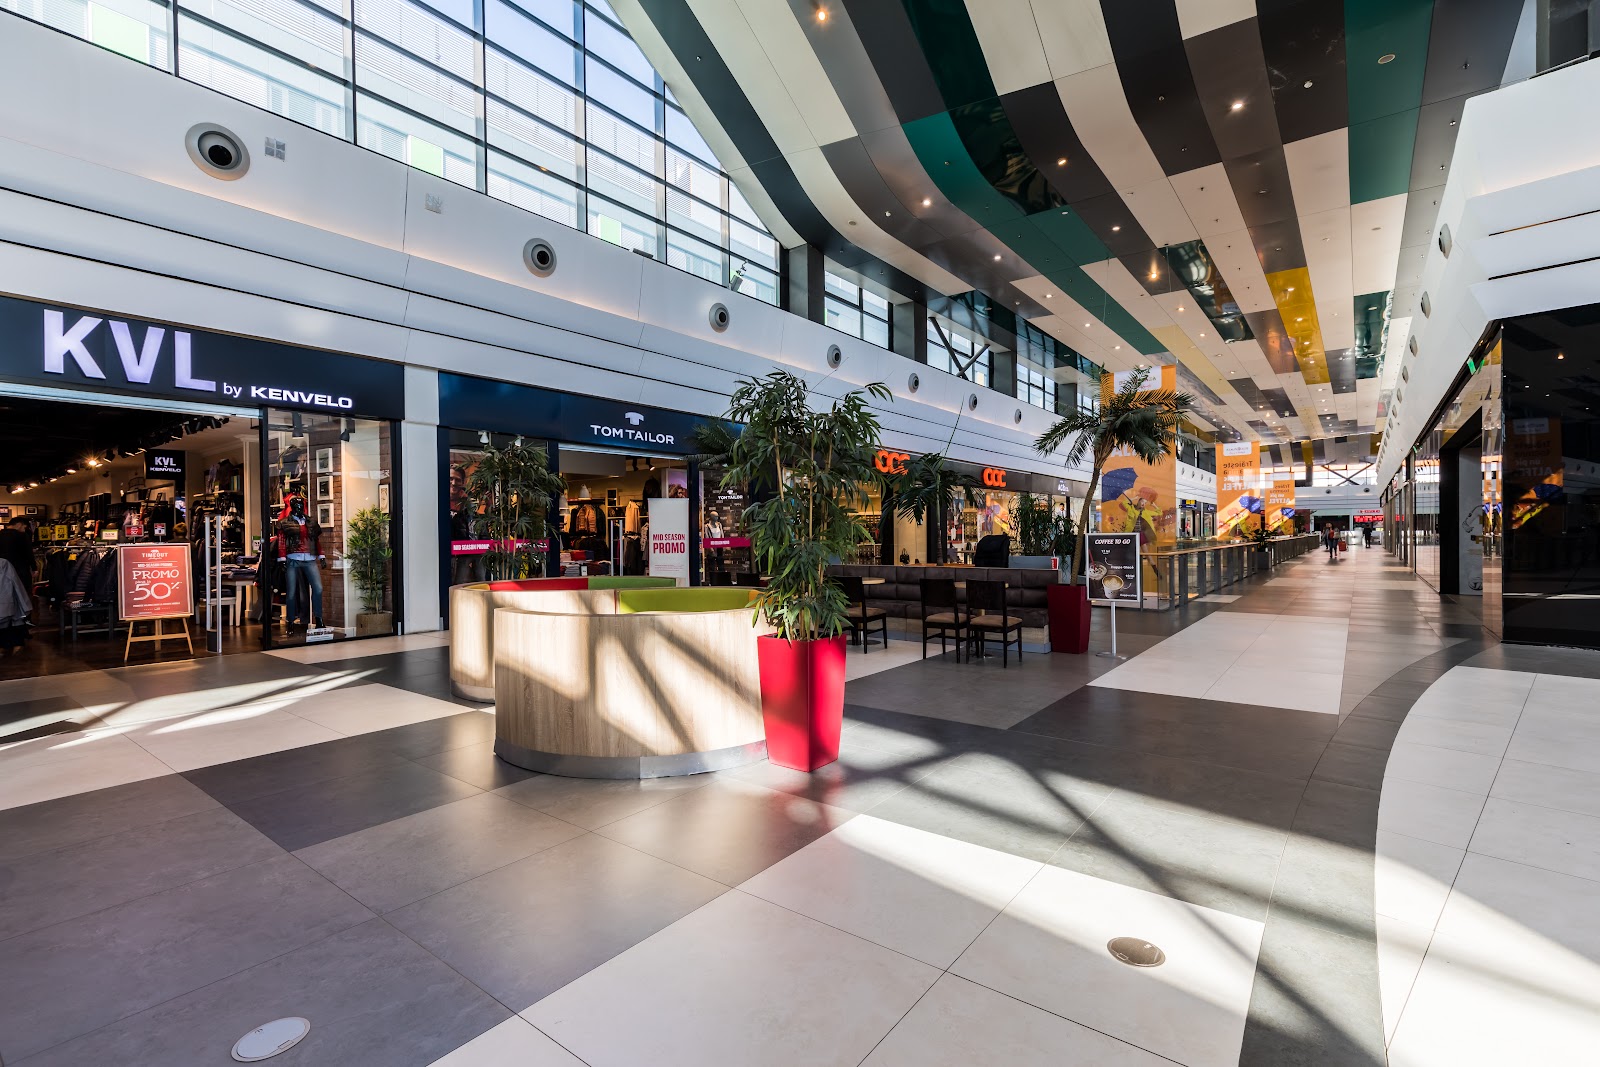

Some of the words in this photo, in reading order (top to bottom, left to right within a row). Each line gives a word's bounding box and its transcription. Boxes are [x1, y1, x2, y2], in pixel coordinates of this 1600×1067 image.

[43, 308, 217, 392] KVL
[223, 382, 243, 398] by
[251, 385, 353, 409] KENVELO
[590, 425, 624, 439] TOM
[625, 429, 675, 445] TAILOR
[154, 456, 177, 466] KVL
[875, 450, 910, 476] CCC
[983, 467, 1007, 488] CCC
[652, 533, 664, 541] MID
[664, 533, 686, 541] SEASON
[653, 541, 686, 554] PROMO
[132, 570, 179, 580] PROMO
[129, 581, 183, 601] -50%
